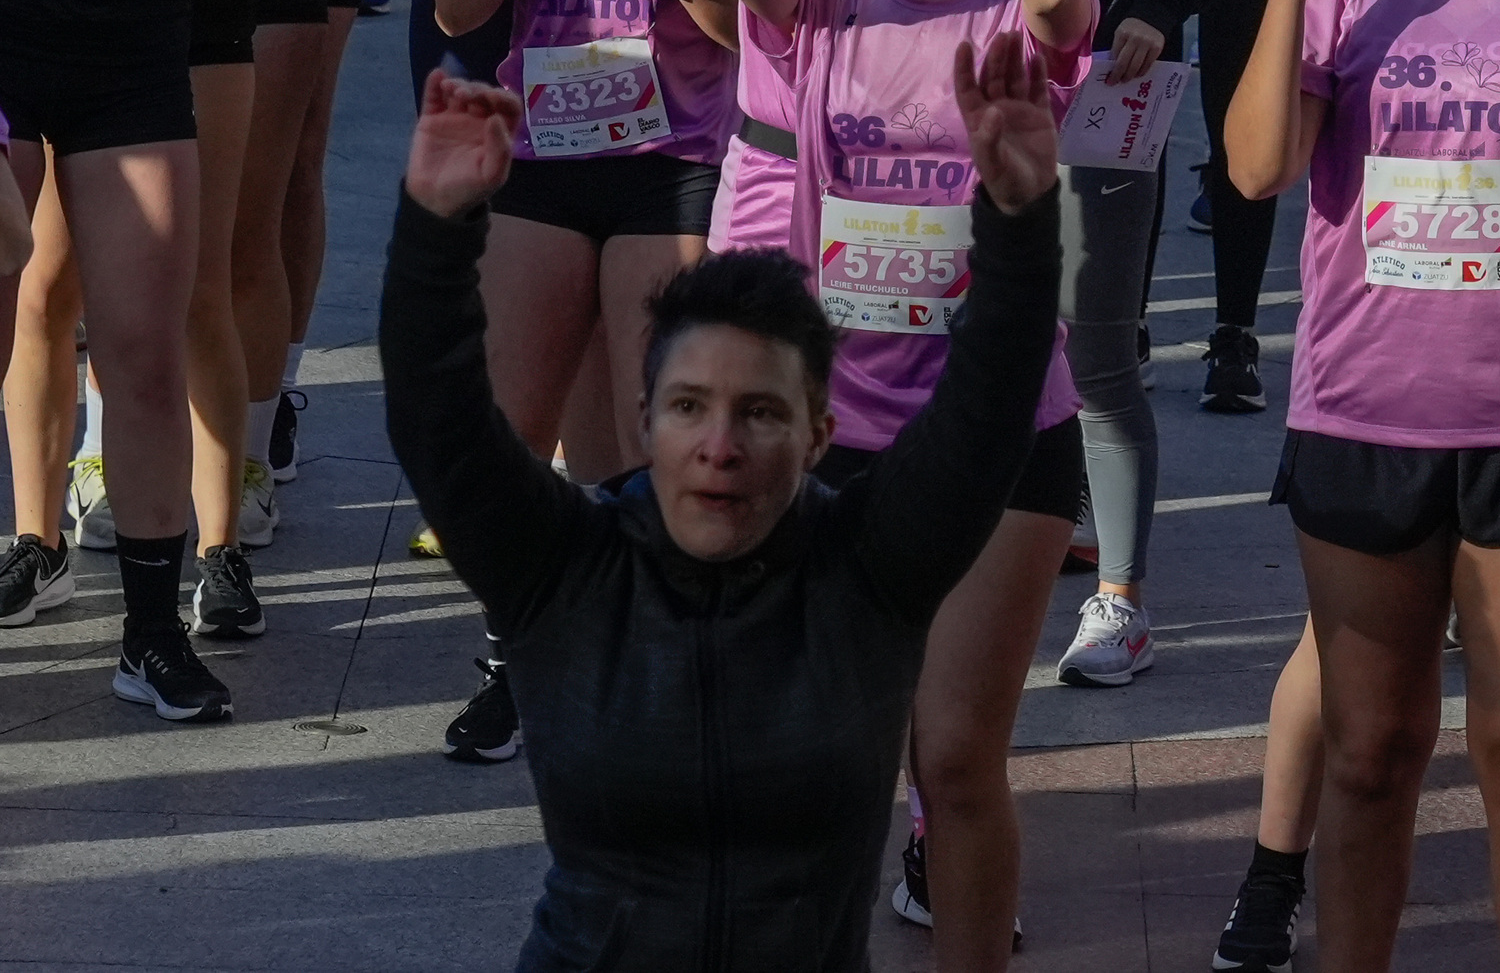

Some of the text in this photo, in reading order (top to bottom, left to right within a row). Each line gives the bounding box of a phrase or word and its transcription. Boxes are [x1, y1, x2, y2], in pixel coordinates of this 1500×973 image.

[1379, 55, 1452, 92] 36.
[545, 72, 641, 113] 3323
[565, 114, 586, 123] SILVA
[1085, 106, 1106, 129] XS
[832, 113, 902, 151] 36.
[1118, 114, 1143, 159] LILATON
[1432, 148, 1467, 157] LABORAL
[833, 156, 976, 190] LILATO
[1394, 176, 1453, 190] LILATON
[844, 217, 900, 235] LILATON
[1397, 242, 1428, 250] ARNAL
[843, 244, 957, 285] 5735
[1372, 255, 1406, 270] ATLETICO
[1414, 259, 1440, 267] LABORAL
[830, 280, 909, 295] LEIRE TRUCHUELO
[824, 296, 856, 311] ATLETICO
[864, 302, 888, 310] LABORAL
